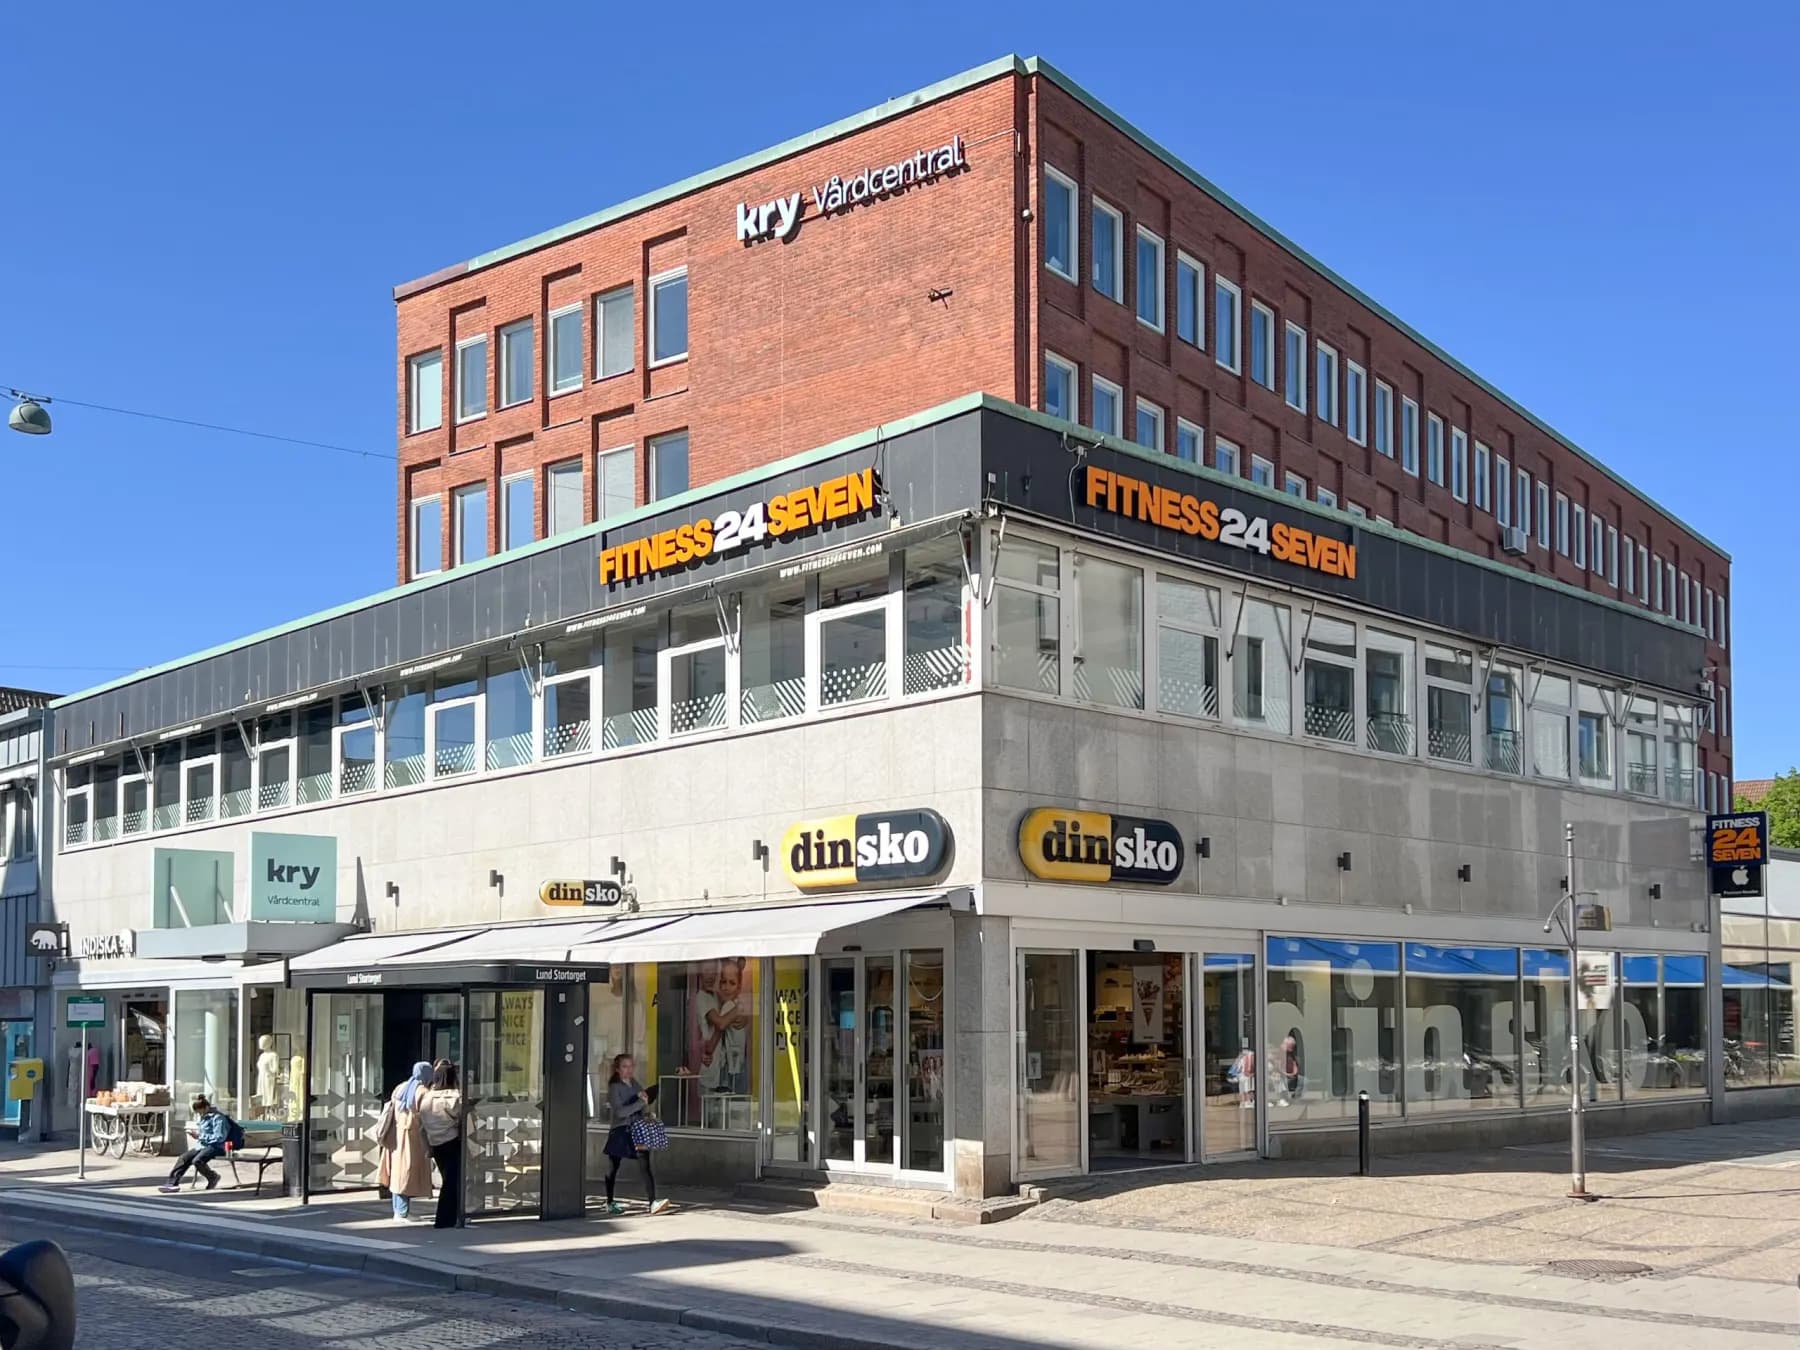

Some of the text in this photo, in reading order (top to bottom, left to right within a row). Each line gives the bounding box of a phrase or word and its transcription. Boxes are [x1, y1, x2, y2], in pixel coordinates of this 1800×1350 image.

[736, 135, 963, 241] kry Vårdcentral
[1711, 817, 1761, 829] FITNESS
[1712, 827, 1760, 850] 24
[1712, 847, 1762, 862] SEVEN
[267, 858, 321, 890] kry
[267, 894, 321, 906] Vårdcentral
[80, 935, 118, 955] INDISKA
[347, 973, 358, 984] Lund
[536, 968, 586, 982] Lund Stortorget
